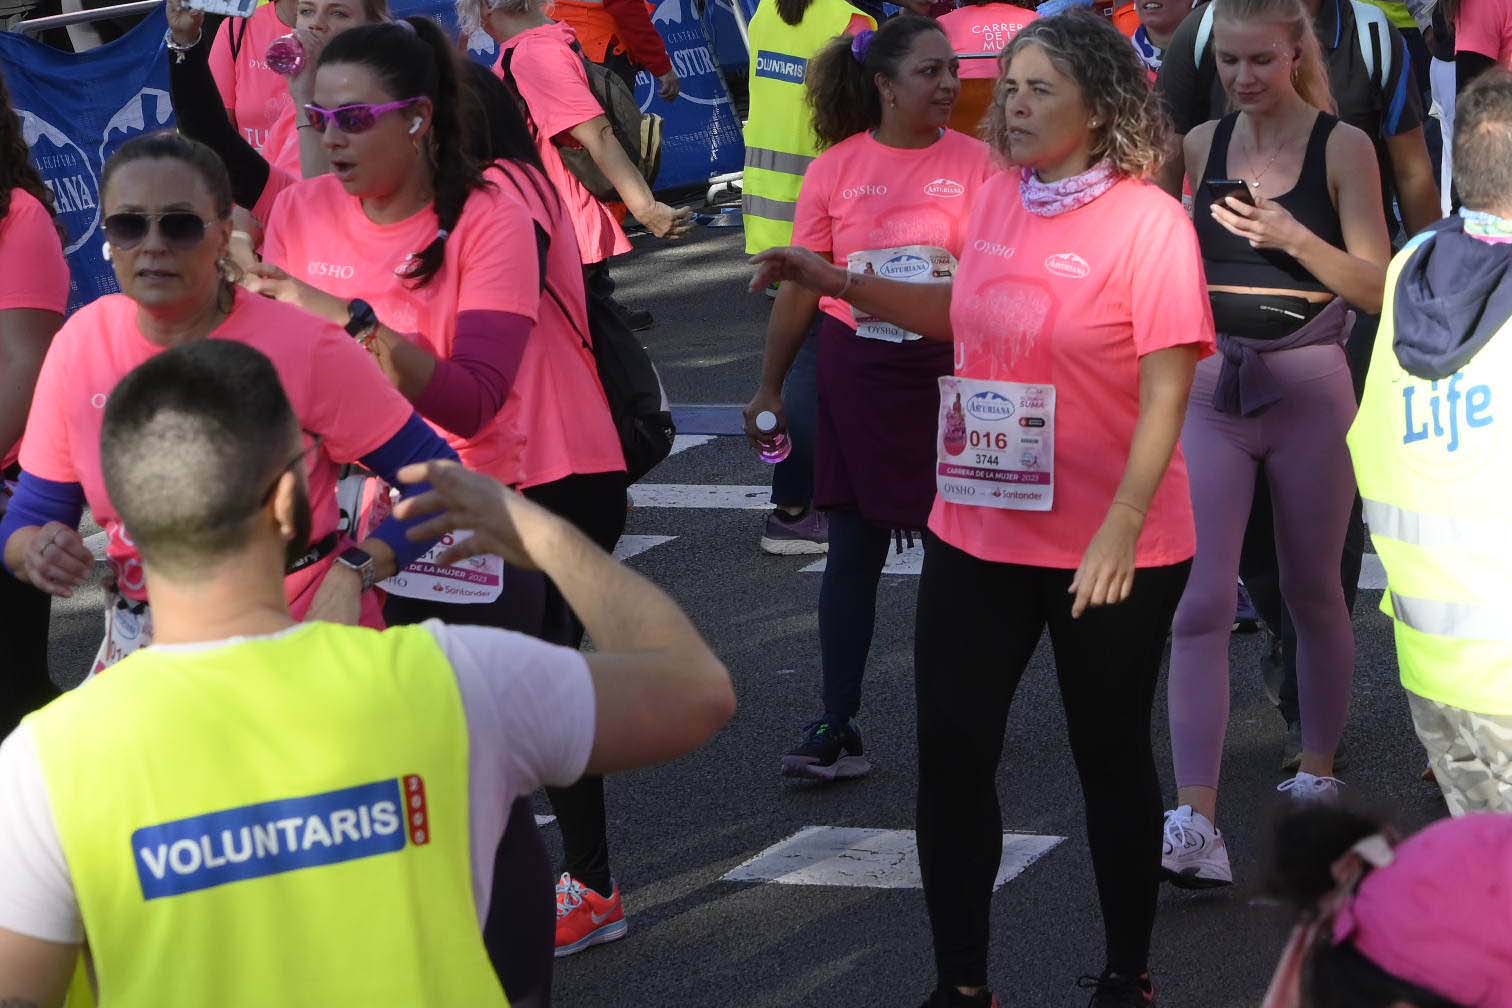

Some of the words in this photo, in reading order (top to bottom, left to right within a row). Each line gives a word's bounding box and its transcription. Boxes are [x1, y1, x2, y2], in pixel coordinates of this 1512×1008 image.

[985, 32, 1002, 41] DE
[843, 185, 888, 199] OYSHO
[884, 263, 927, 275] ASTURIANA
[867, 325, 898, 336] OYSHO
[969, 401, 1011, 415] ASTURIANA
[1402, 373, 1494, 451] Life
[969, 430, 1008, 450] 016
[975, 453, 999, 467] 3744
[944, 483, 976, 497] OYSHO
[1002, 487, 1042, 501] Santander
[410, 562, 422, 572] DE
[424, 565, 434, 573] LA
[438, 567, 465, 578] MUJER
[445, 584, 490, 597] Santander
[140, 800, 399, 880] VOLUNTARIS
